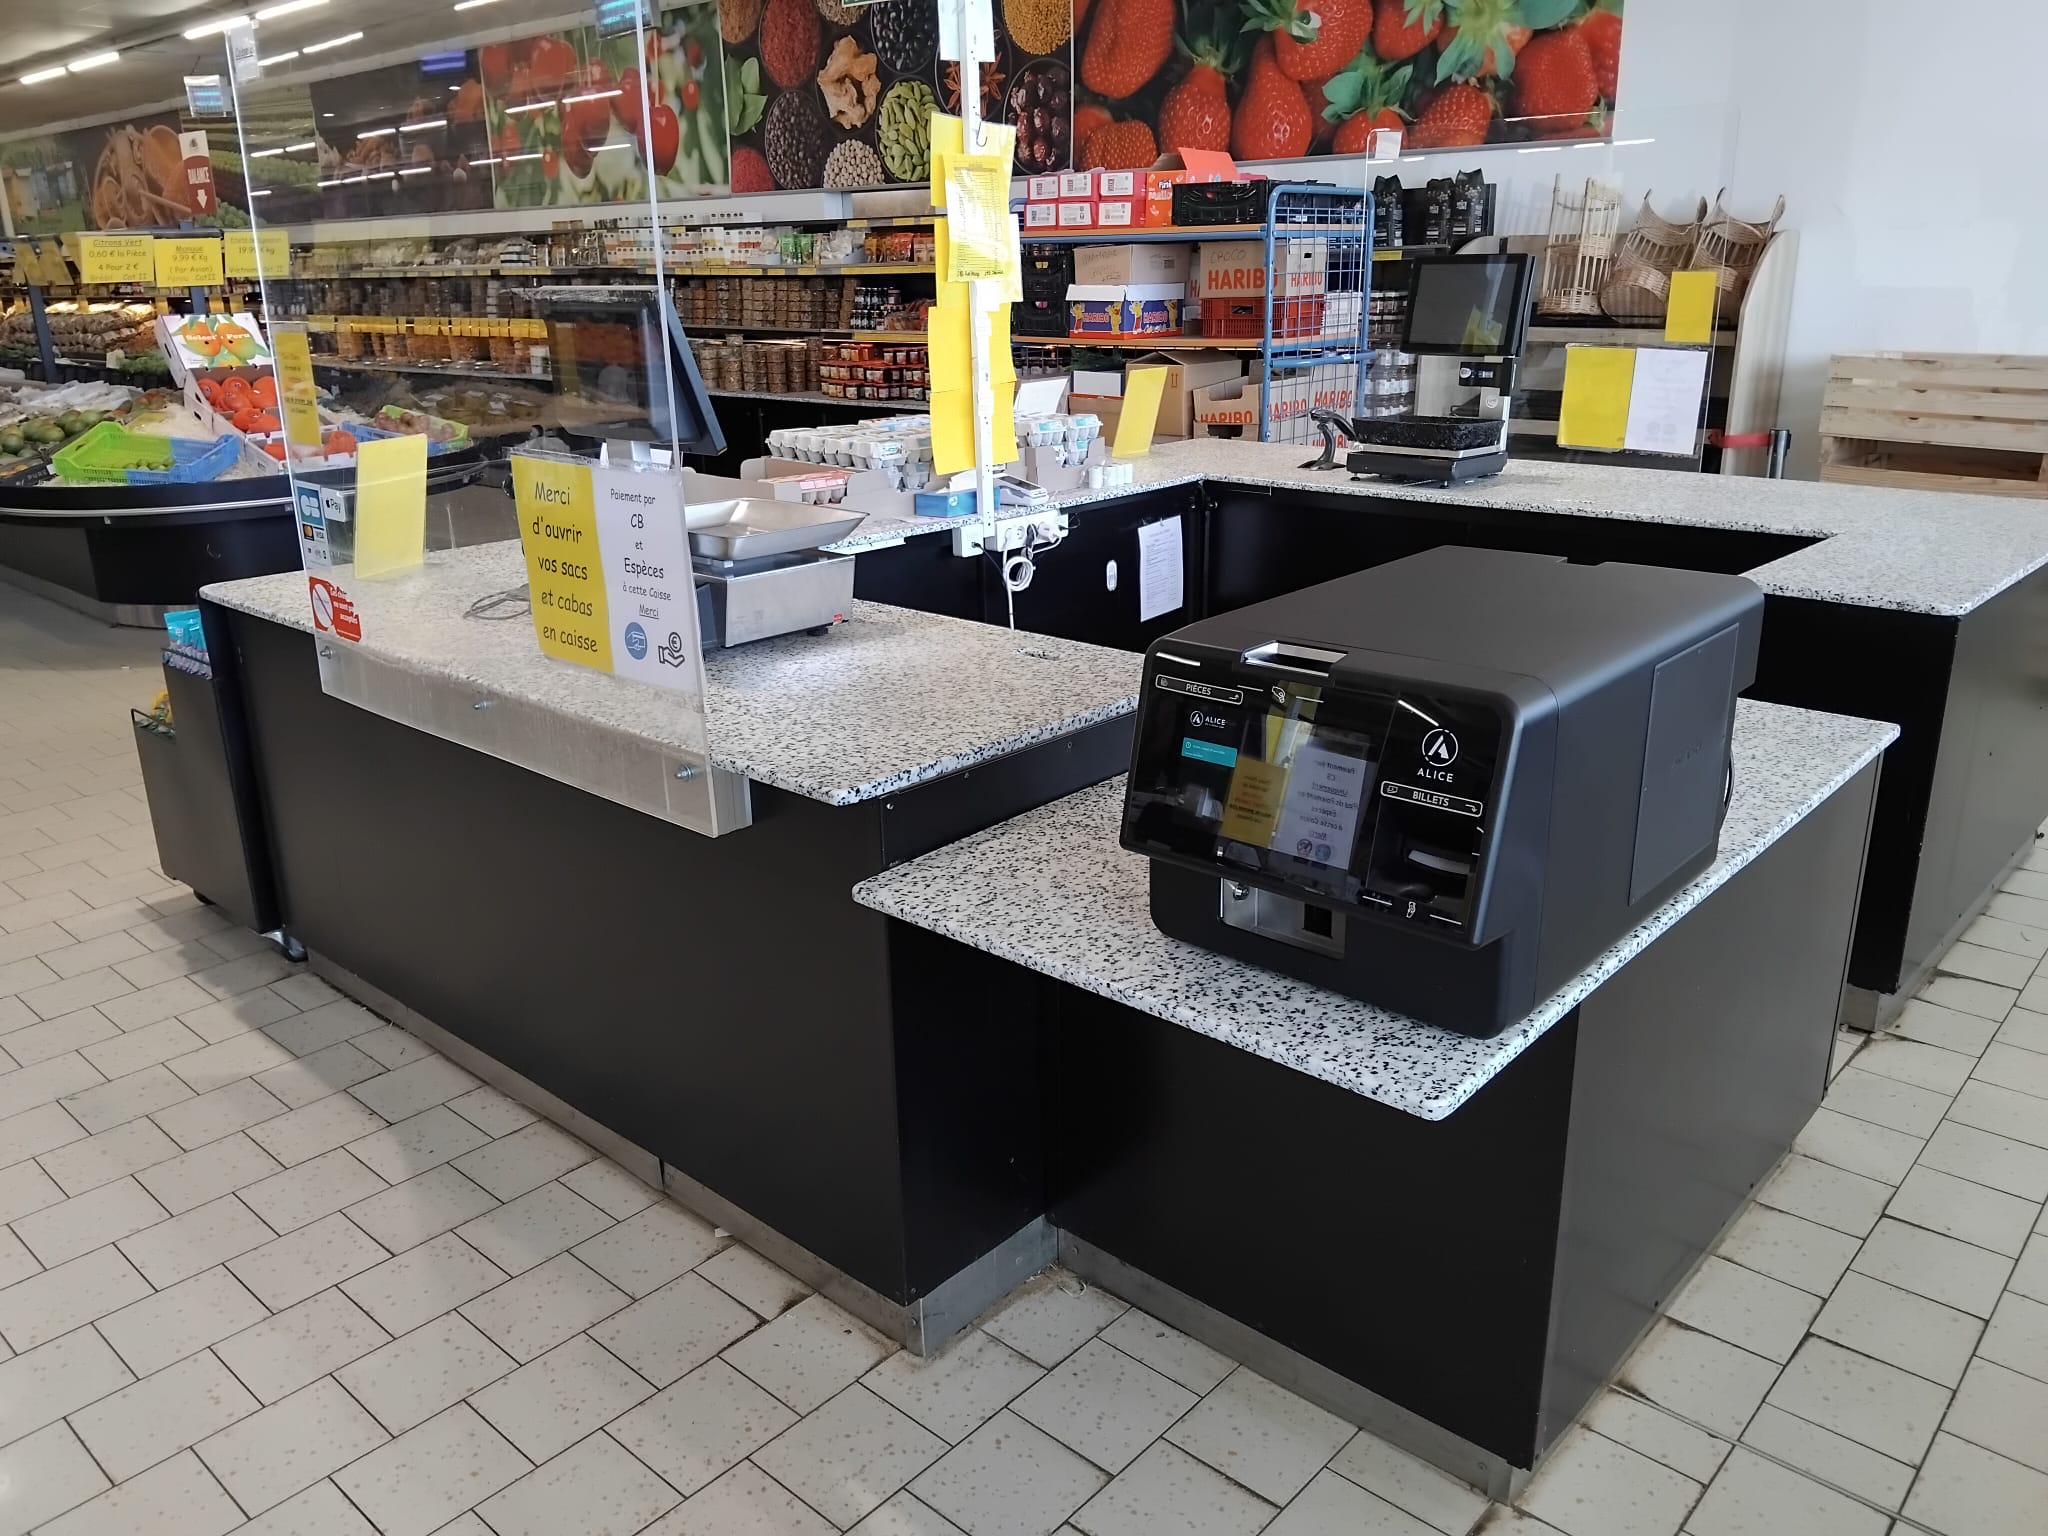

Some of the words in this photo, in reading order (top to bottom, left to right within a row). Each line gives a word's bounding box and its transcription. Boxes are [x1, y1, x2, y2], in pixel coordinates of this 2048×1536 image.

[187, 167, 210, 184] BALANCE
[535, 481, 570, 506] Merci
[610, 488, 642, 504] Paiement
[644, 495, 656, 508] par
[330, 501, 342, 514] Pay
[630, 513, 644, 529] CB
[533, 516, 582, 544] d'ouvrir
[635, 541, 643, 551] et
[538, 556, 557, 571] vos
[561, 561, 588, 581] sacs
[624, 557, 664, 580] Espèces
[623, 582, 628, 592] à
[628, 584, 647, 597] cette
[649, 587, 671, 601] Caisse
[541, 590, 554, 606] et
[557, 593, 593, 617] cabas
[639, 604, 659, 617] Merci
[543, 626, 556, 641] en
[560, 629, 598, 653] caisse
[1185, 683, 1212, 696] PIÈCES
[1204, 716, 1226, 726] ALICE
[1416, 768, 1454, 783] ALICE
[1412, 791, 1450, 806] BILLETS
